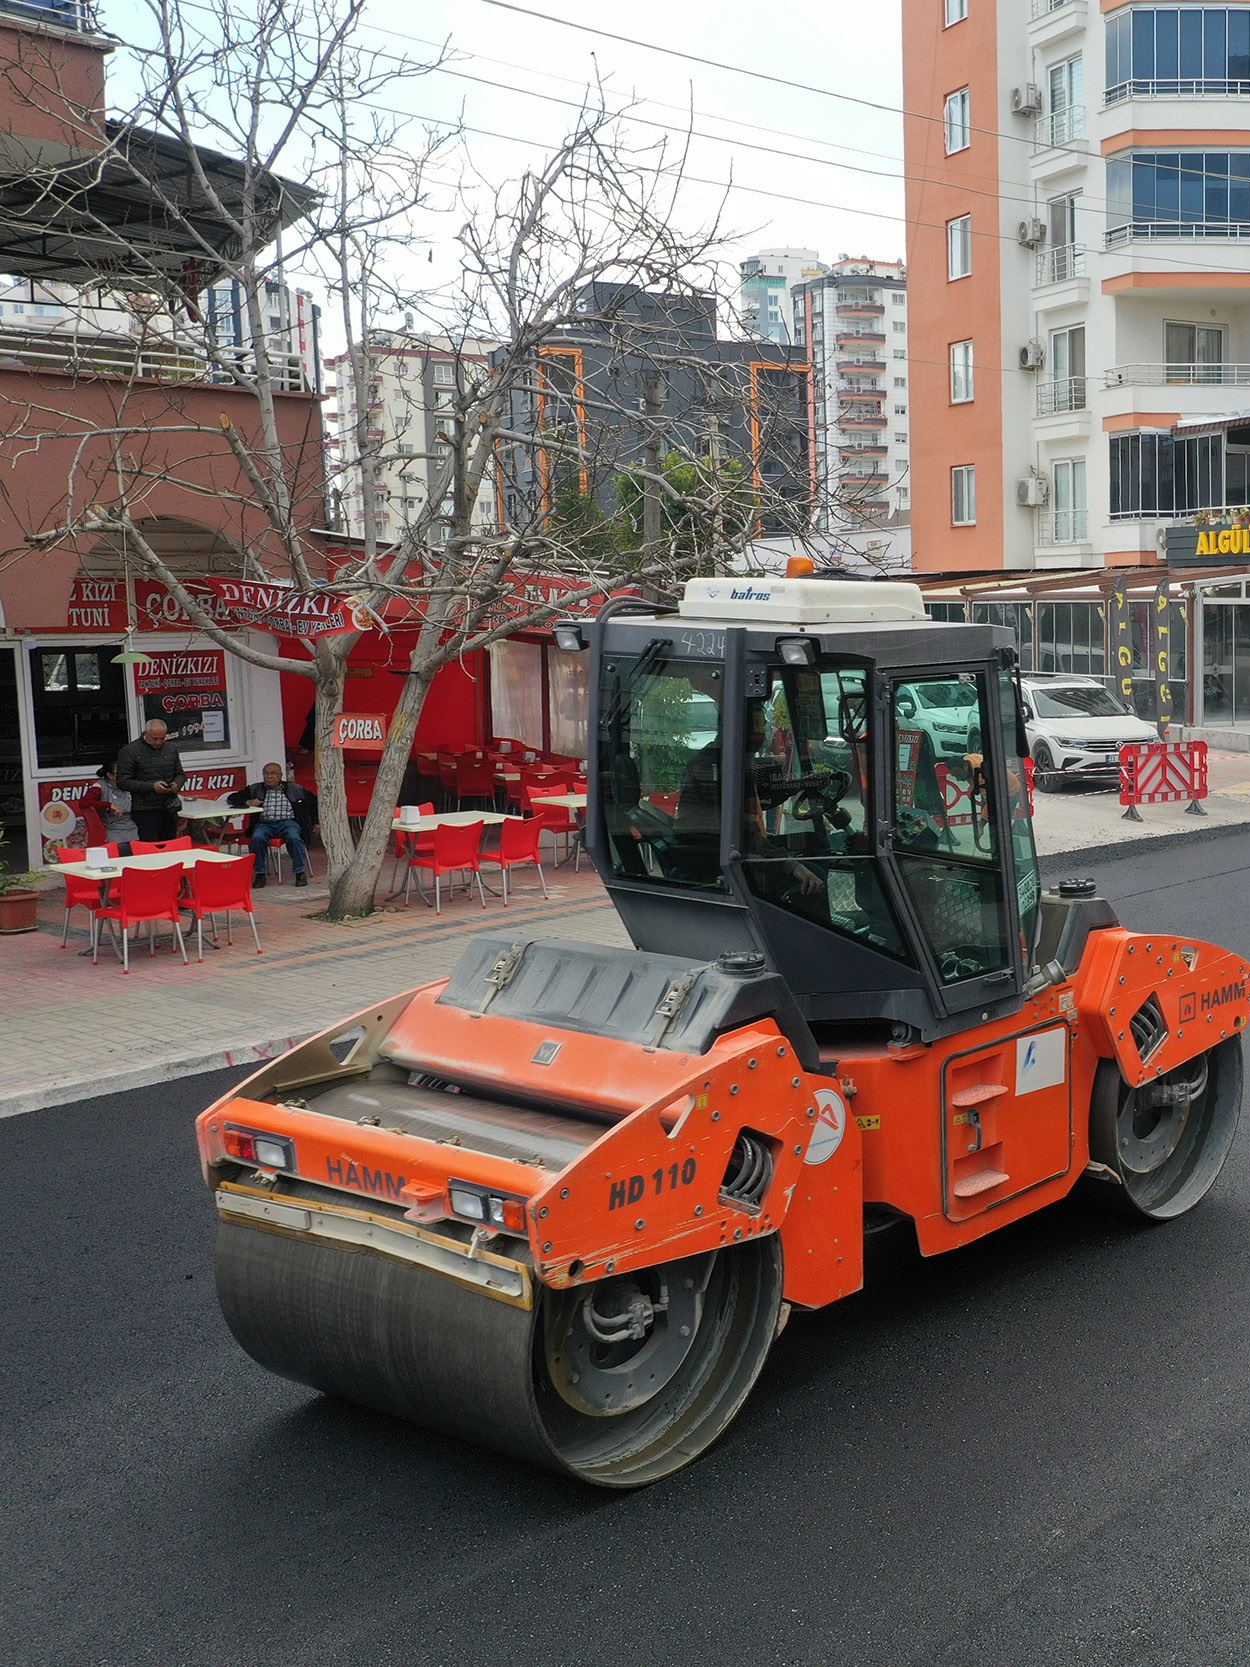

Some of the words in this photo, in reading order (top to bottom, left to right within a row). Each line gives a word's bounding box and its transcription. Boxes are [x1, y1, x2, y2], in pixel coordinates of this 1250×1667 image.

[82, 582, 117, 601] KIZI
[681, 631, 726, 659] 4224
[137, 653, 219, 677] DENİZKIZI
[339, 718, 383, 744] ÇORBA
[207, 774, 234, 790] KIZI
[1200, 979, 1246, 1012] HAMM
[609, 1174, 645, 1212] HD
[652, 1157, 697, 1196] 110
